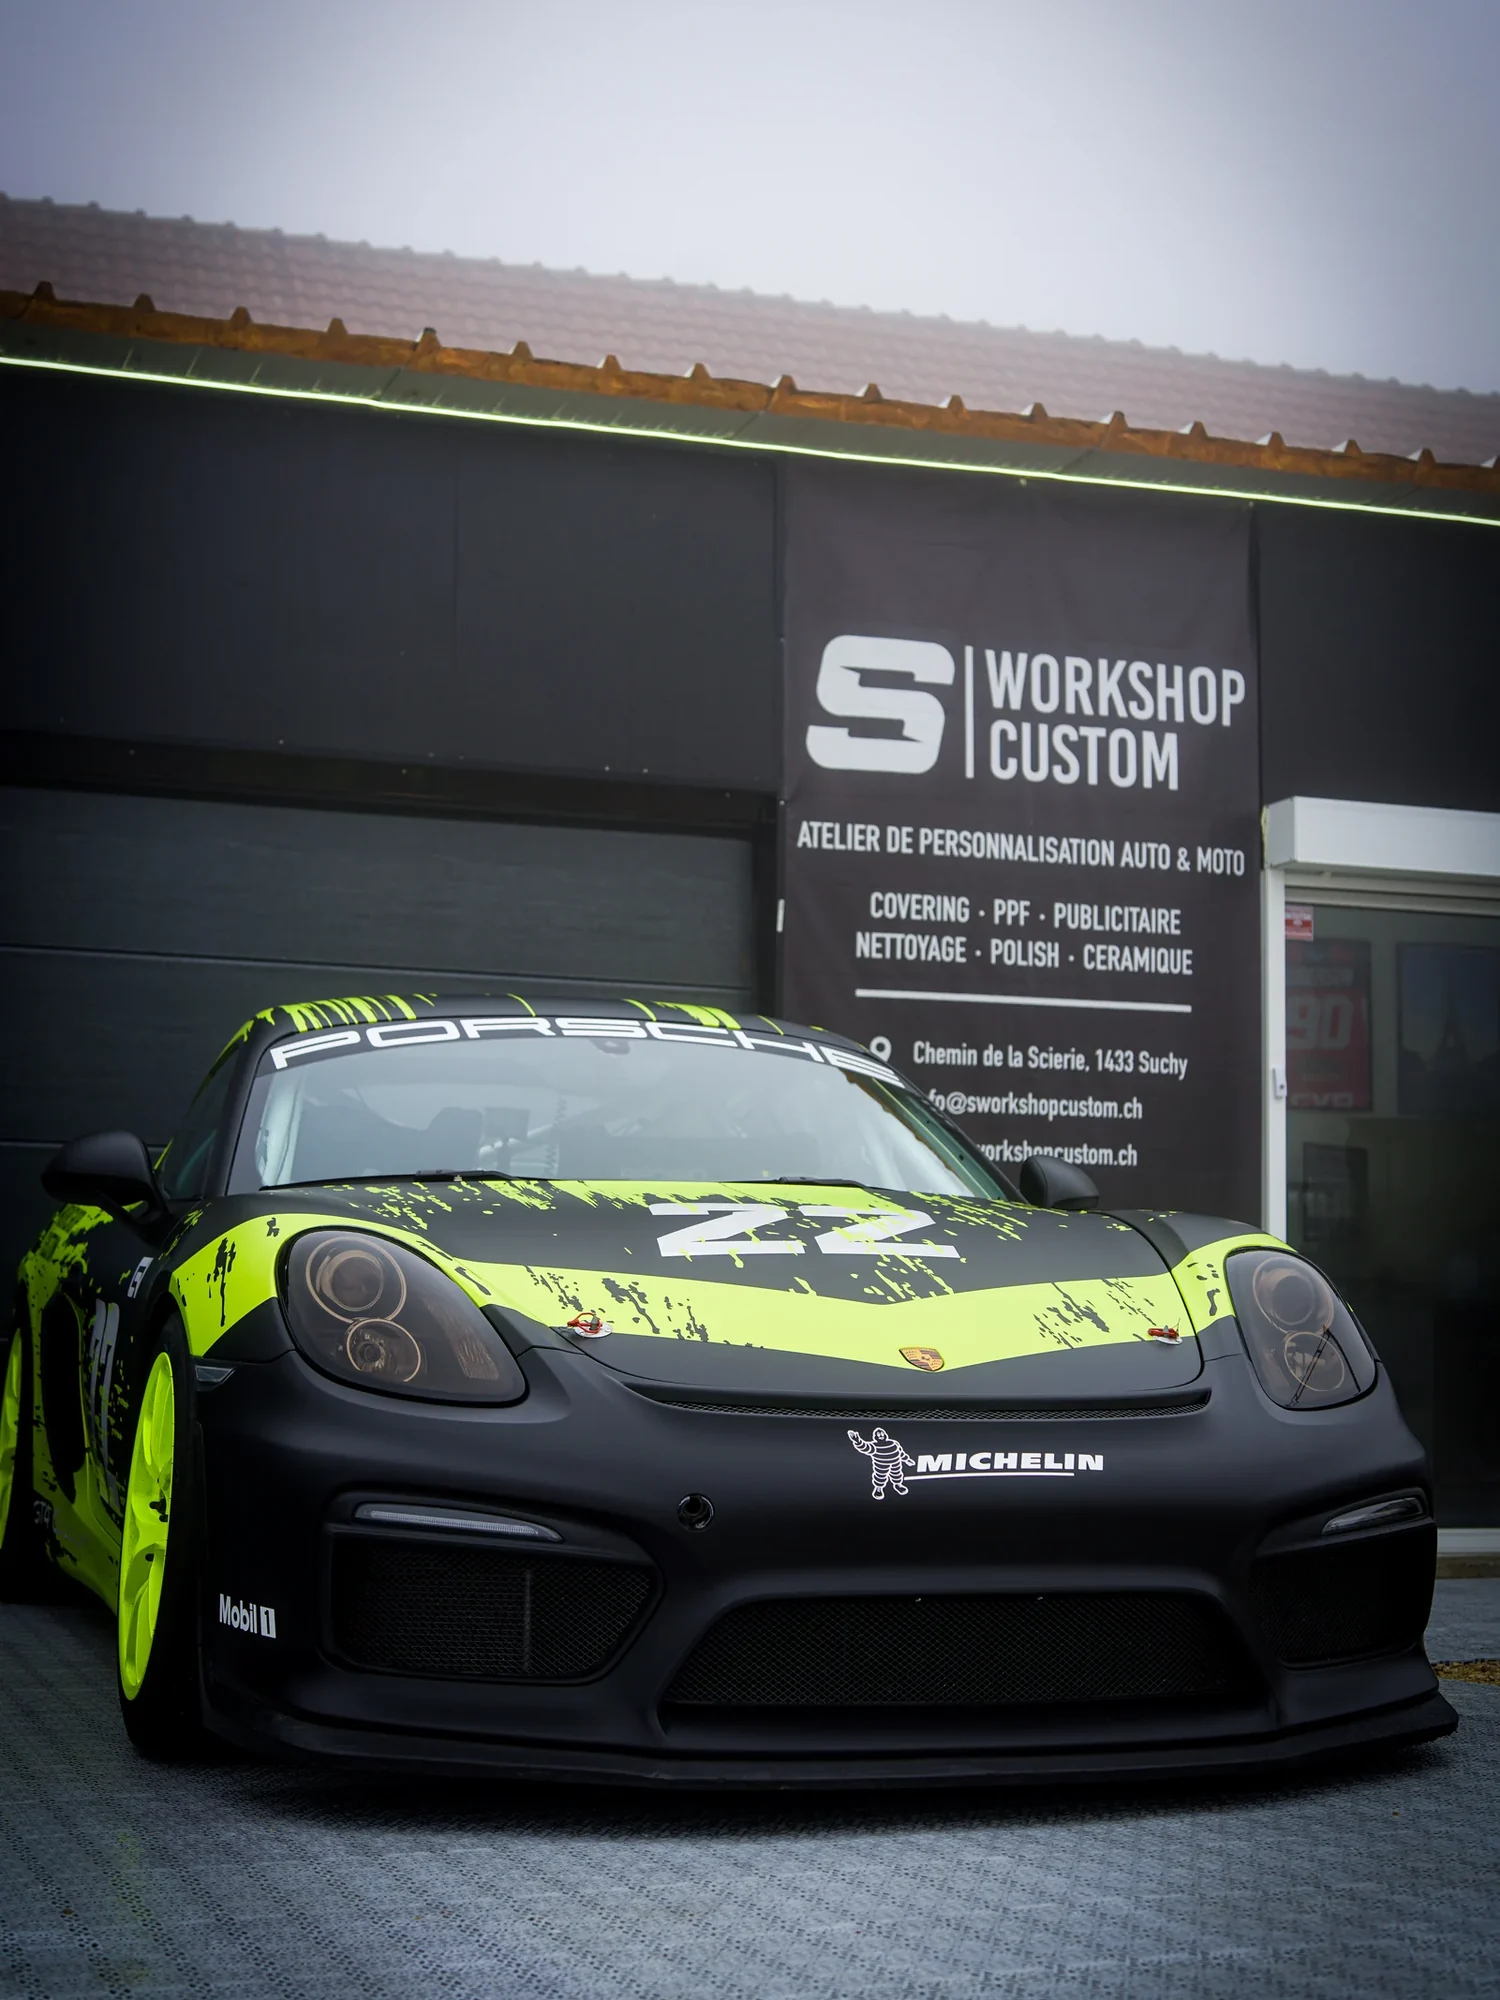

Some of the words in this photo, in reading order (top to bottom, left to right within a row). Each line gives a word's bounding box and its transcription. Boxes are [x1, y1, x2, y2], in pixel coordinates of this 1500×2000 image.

[985, 649, 1246, 726] WORKSHOP
[990, 720, 1179, 790] CUSTOM
[797, 821, 880, 852] ATELIER
[887, 826, 914, 855] DE
[919, 828, 1114, 867] PERSONNALISATION
[1120, 841, 1170, 870] AUTO
[1177, 847, 1191, 871] &
[1197, 846, 1245, 876] MOTO
[870, 892, 970, 923] COVERING
[993, 899, 1031, 927] PPF
[1053, 903, 1181, 935] PUBLICITAIRE
[855, 932, 967, 963] NETTOYAGE
[990, 938, 1060, 968] POLISH
[1083, 944, 1193, 975] CERAMIQUE
[269, 1015, 906, 1089] PORSCHE
[913, 1041, 978, 1066] Chemin
[983, 1044, 1004, 1067] de
[1008, 1045, 1024, 1068] la
[1028, 1046, 1090, 1072] Scierie,
[1096, 1049, 1134, 1074] 1433
[1138, 1051, 1188, 1081] Suchy
[928, 1088, 1143, 1121] fo@sworkshopcustom.ch
[650, 1203, 959, 1259] 22
[916, 1452, 1105, 1472] MICHELIN
[219, 1593, 258, 1635] Mobil
